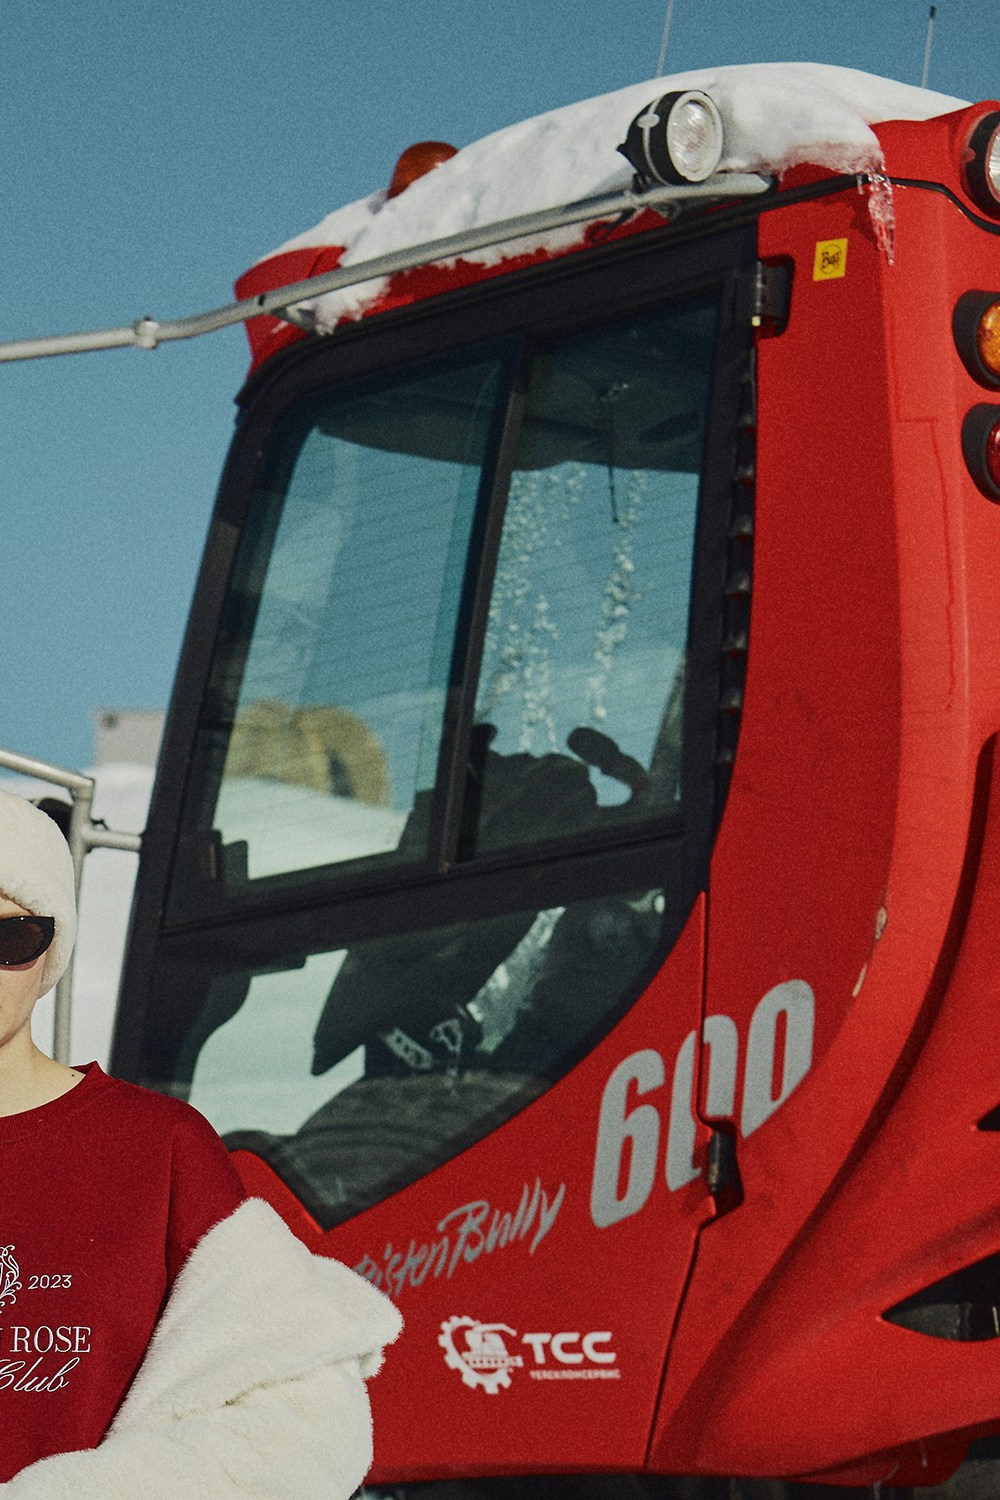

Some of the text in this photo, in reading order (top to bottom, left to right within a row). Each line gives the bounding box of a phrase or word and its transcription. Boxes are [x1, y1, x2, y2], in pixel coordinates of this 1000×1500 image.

[590, 978, 815, 1229] 600
[28, 1274, 73, 1290] 2023
[9, 1325, 92, 1353] ROSE
